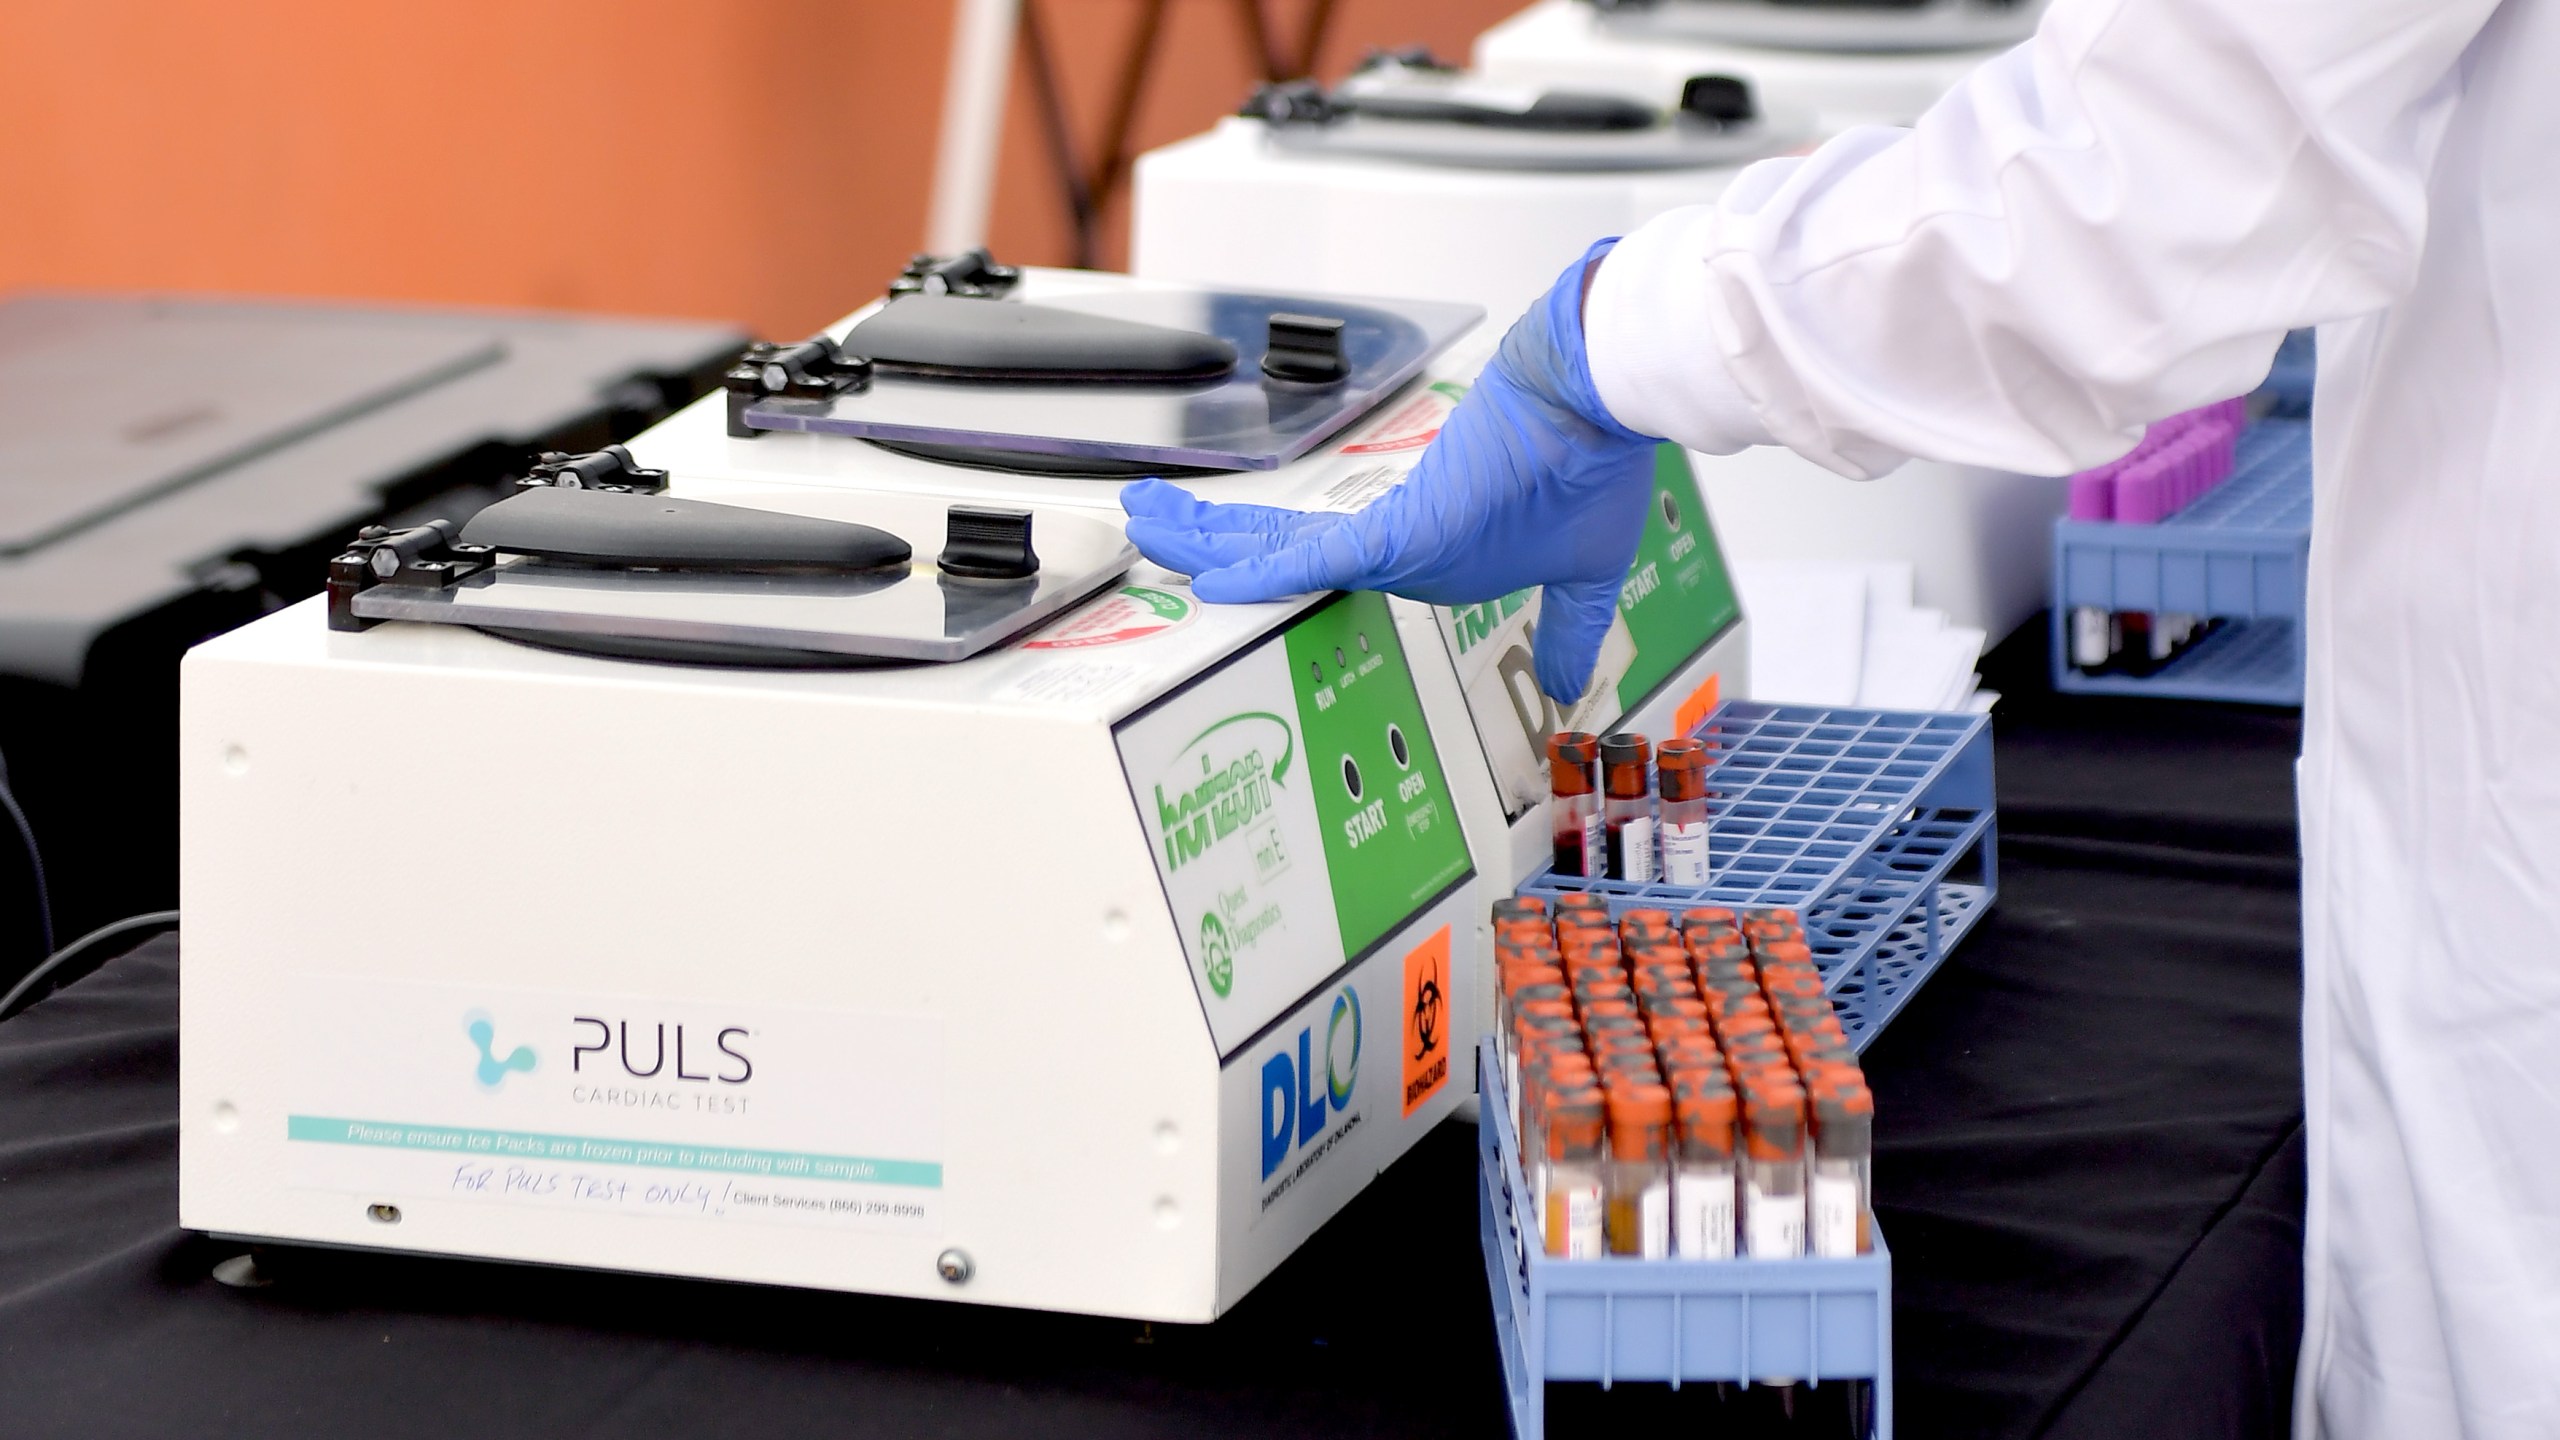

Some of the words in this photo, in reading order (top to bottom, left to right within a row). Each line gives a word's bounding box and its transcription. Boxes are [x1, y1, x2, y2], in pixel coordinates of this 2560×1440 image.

[1671, 531, 1697, 562] OPEN
[1622, 561, 1661, 610] START
[1315, 684, 1337, 711] RUN
[1398, 770, 1427, 803] OPEN
[1344, 798, 1388, 849] START
[573, 1016, 753, 1084] PULS
[572, 1085, 681, 1111] CARDIAC
[695, 1093, 750, 1115] TEST
[1261, 984, 1363, 1185] DLO
[1406, 1056, 1446, 1106] BIOHAZARD
[347, 1122, 403, 1144] Please
[407, 1129, 462, 1148] ensure
[467, 1132, 490, 1150] Ice
[496, 1135, 545, 1154] Packs
[551, 1142, 576, 1157] are
[582, 1141, 632, 1161] frozen
[637, 1147, 673, 1165] prior
[679, 1149, 695, 1164] to
[699, 1149, 771, 1173] including
[777, 1153, 809, 1174] with
[815, 1161, 877, 1179] sample.
[504, 1164, 560, 1195] PULS
[733, 1190, 769, 1207] Client
[772, 1194, 826, 1211] Services
